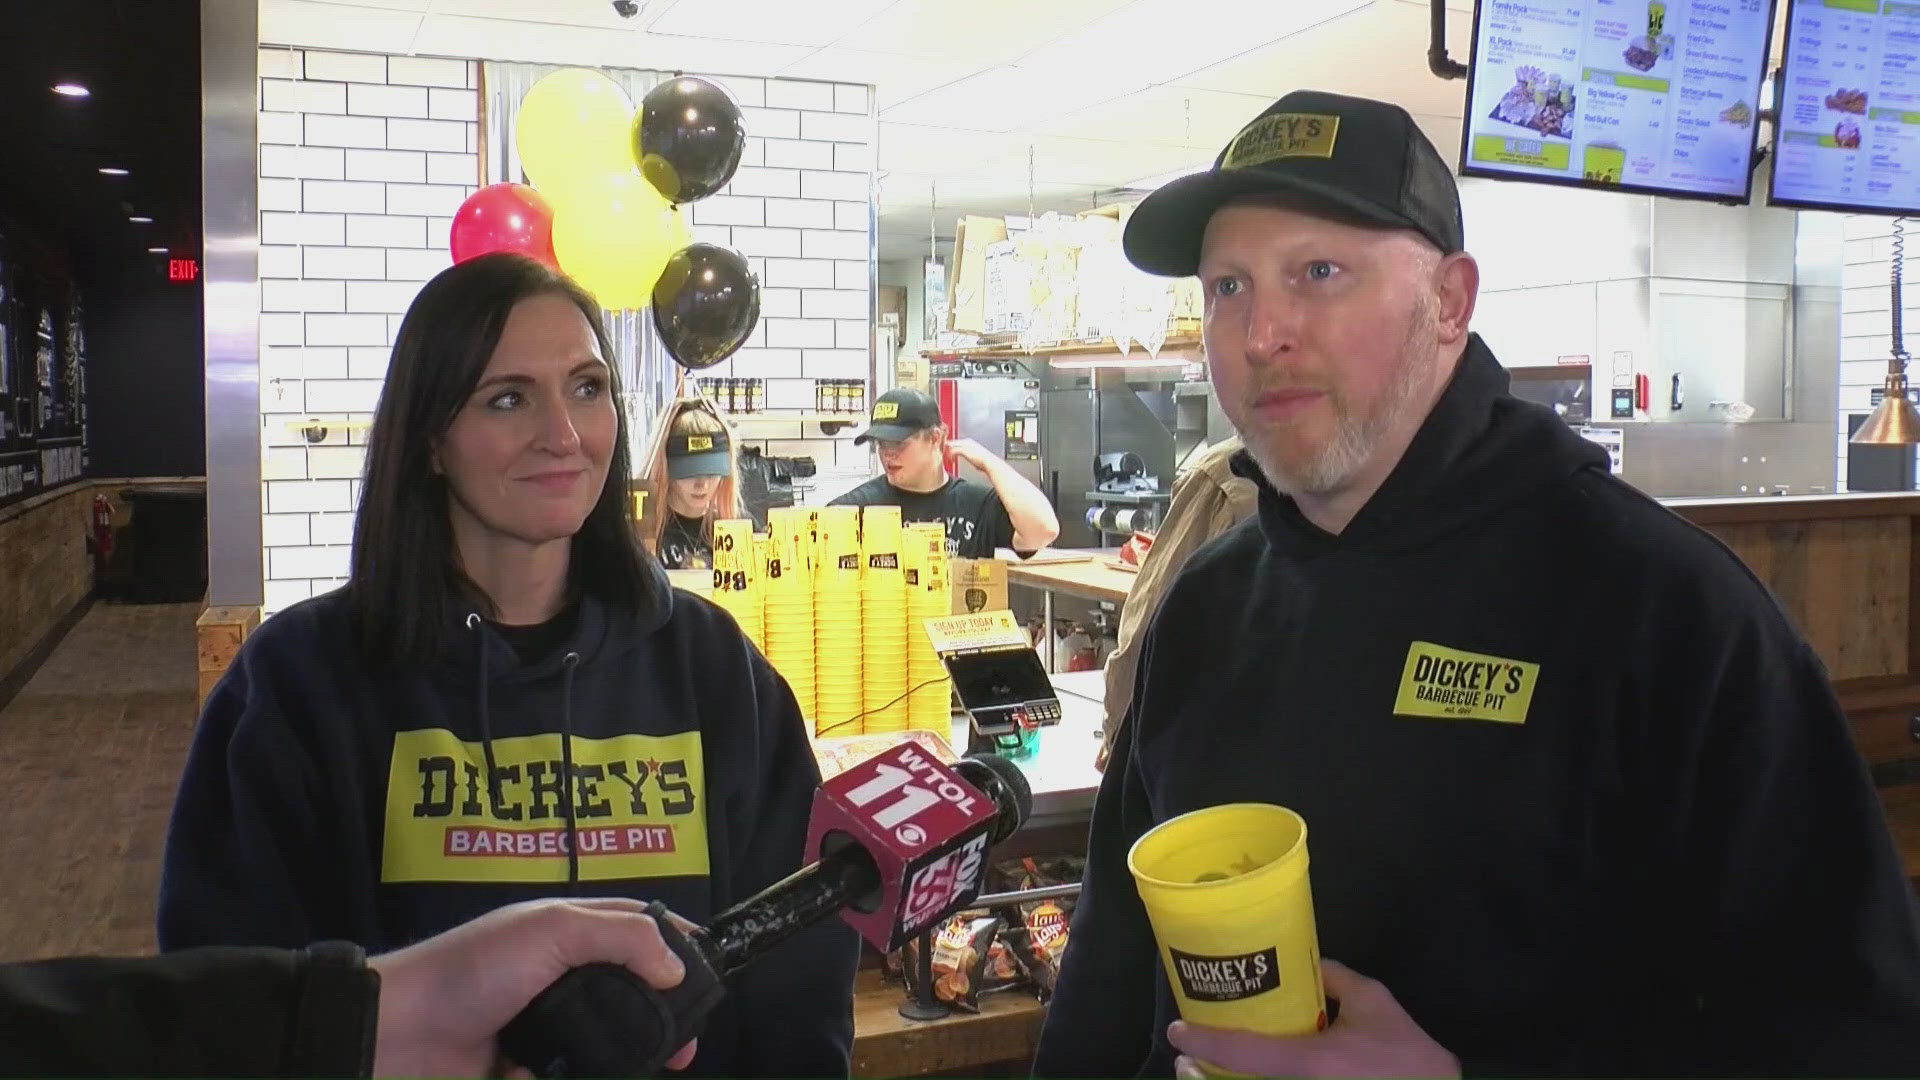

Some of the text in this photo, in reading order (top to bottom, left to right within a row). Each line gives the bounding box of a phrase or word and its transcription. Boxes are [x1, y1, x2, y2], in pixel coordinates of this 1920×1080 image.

[170, 259, 196, 279] EXIT
[968, 617, 994, 629] TODAY
[1416, 685, 1507, 711] BARBECUE PIT
[898, 747, 978, 817] WTOL
[844, 763, 942, 831] 11
[451, 828, 668, 854] BARBECUE PIT
[949, 831, 989, 903] FOX
[1244, 976, 1262, 991] PIT
